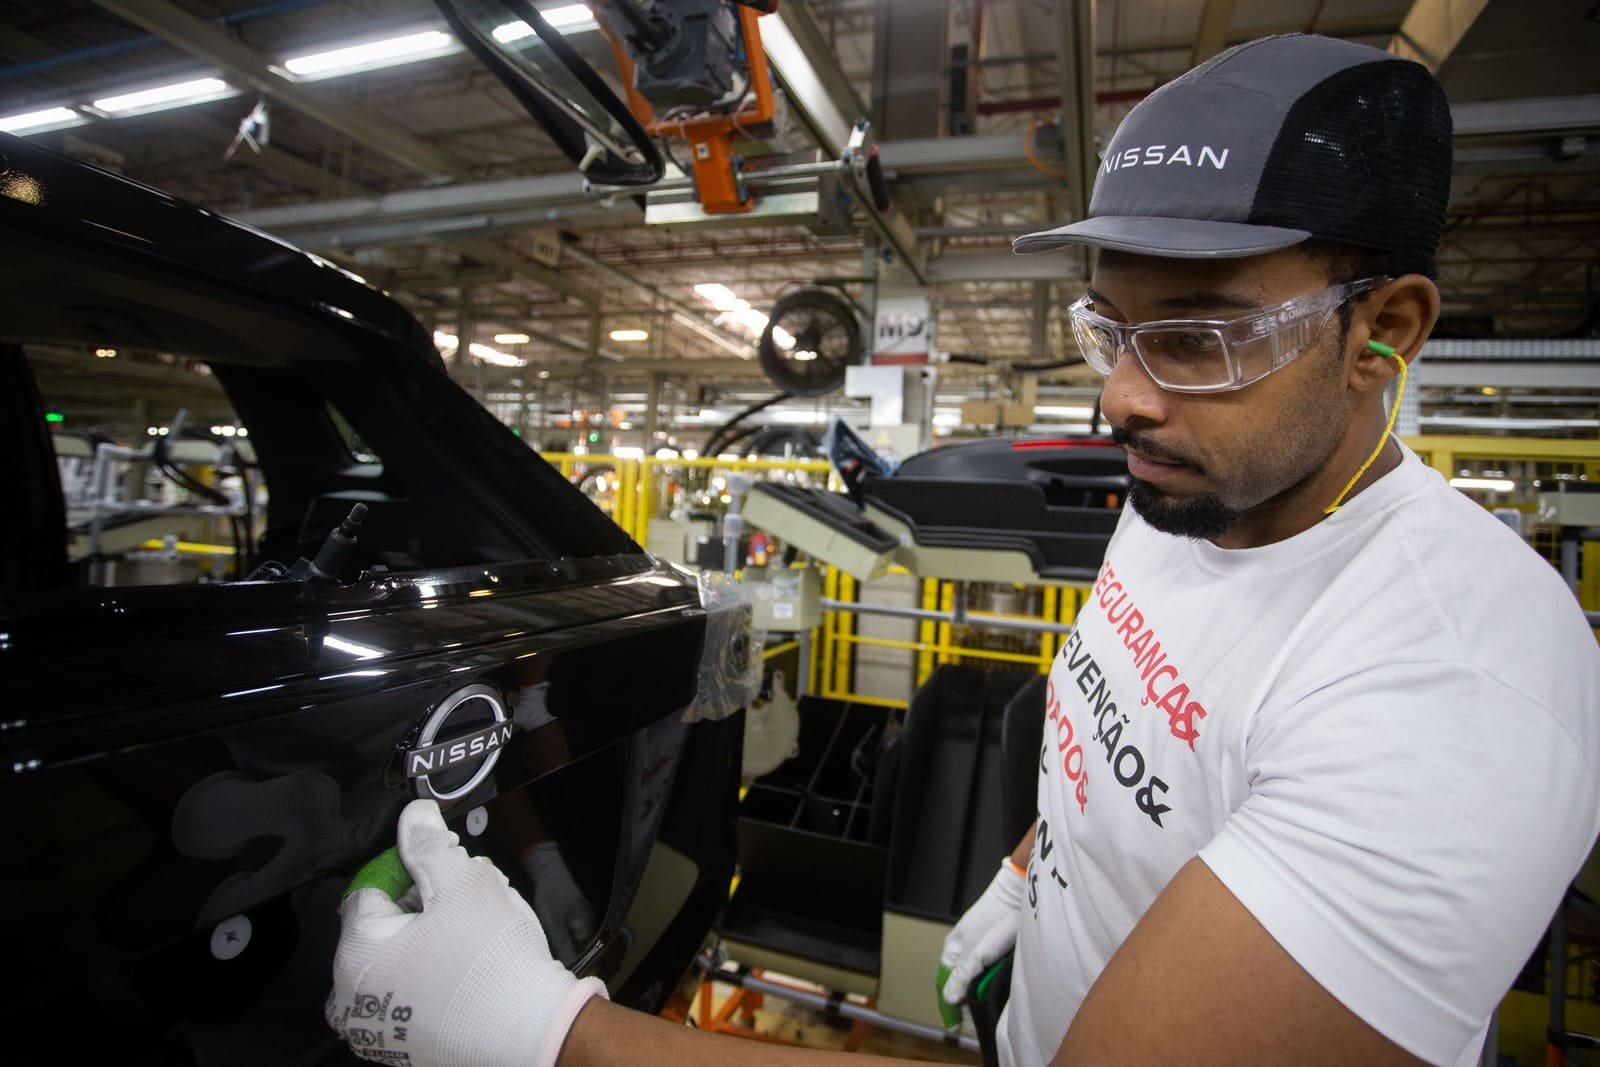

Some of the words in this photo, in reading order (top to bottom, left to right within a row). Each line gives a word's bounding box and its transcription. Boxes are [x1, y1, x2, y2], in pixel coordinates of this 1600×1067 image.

[1101, 144, 1229, 177] NISSAN
[1063, 623, 1173, 829] EVENÇÃO&
[412, 723, 513, 774] NISSAN
[391, 1005, 412, 1022] 8
[393, 1026, 408, 1041] M
